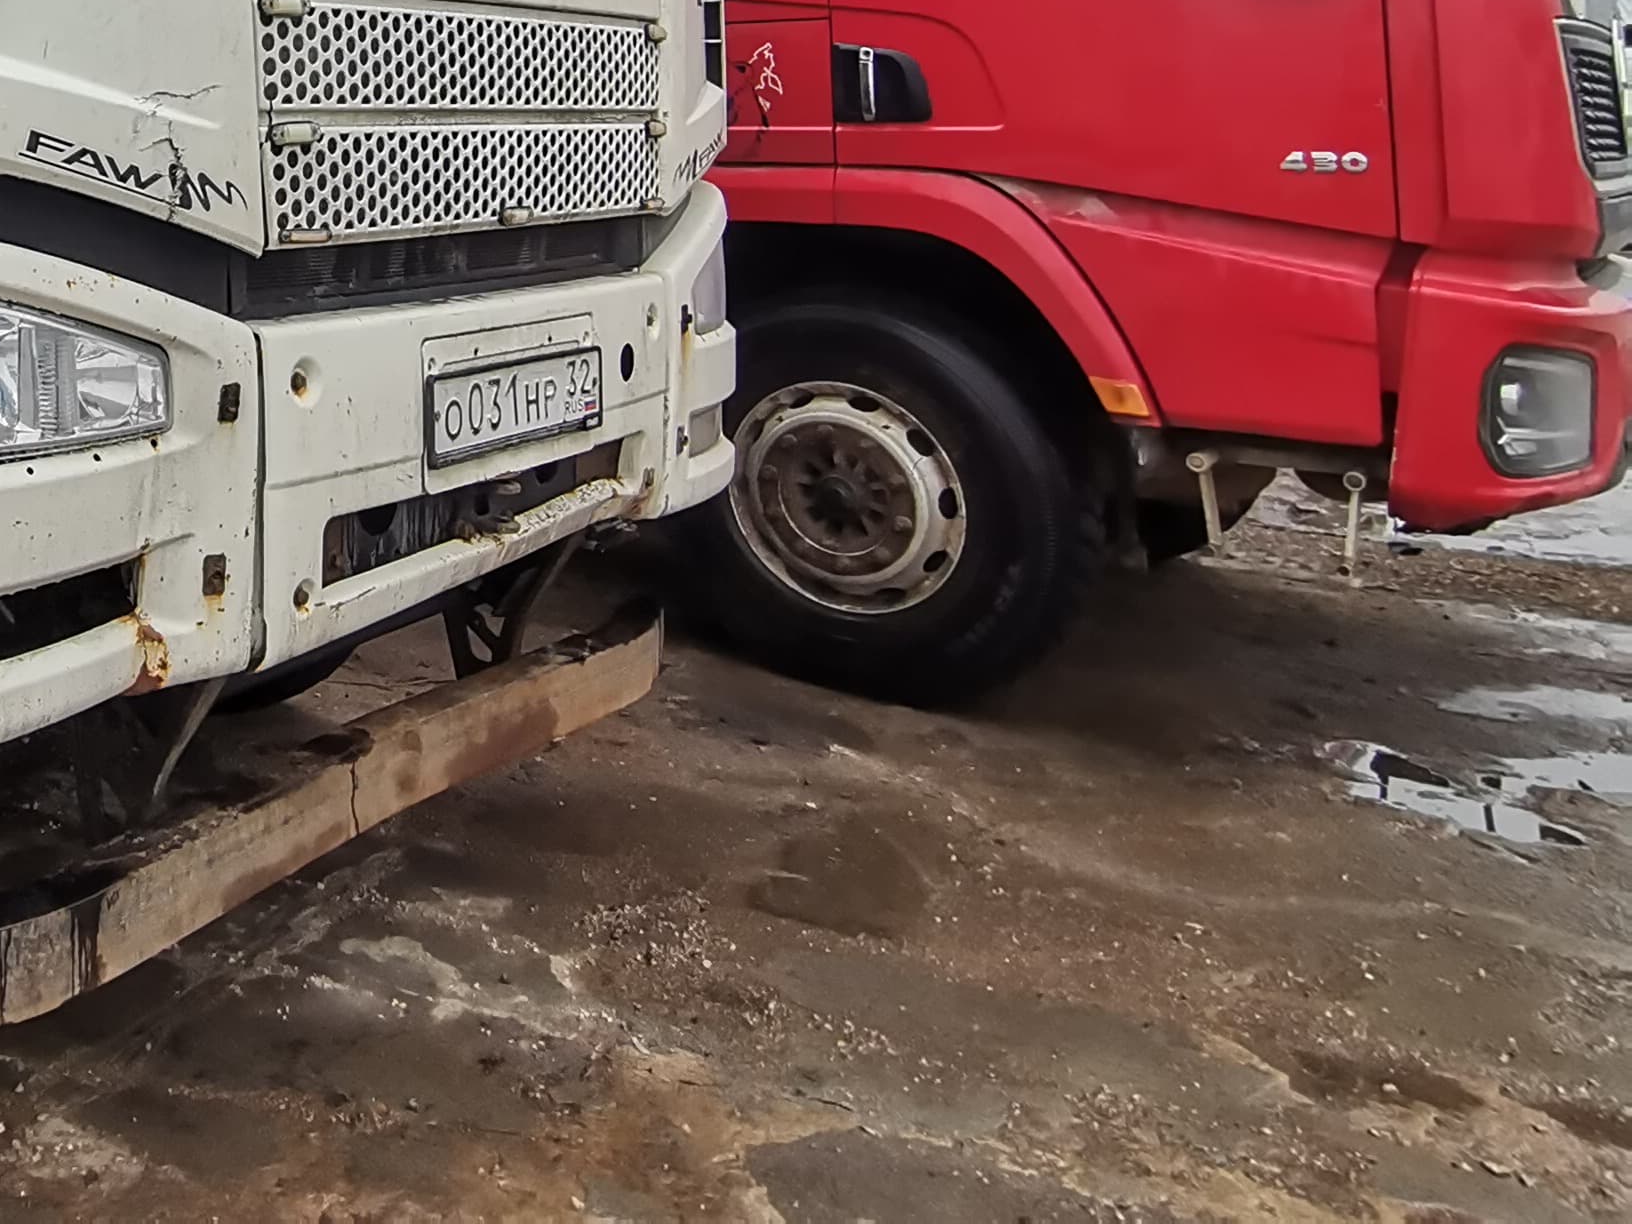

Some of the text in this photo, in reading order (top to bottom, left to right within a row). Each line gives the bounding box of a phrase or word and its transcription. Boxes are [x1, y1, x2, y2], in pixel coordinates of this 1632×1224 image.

[1279, 151, 1368, 173] 430
[566, 358, 591, 396] 32
[565, 398, 583, 414] RUS
